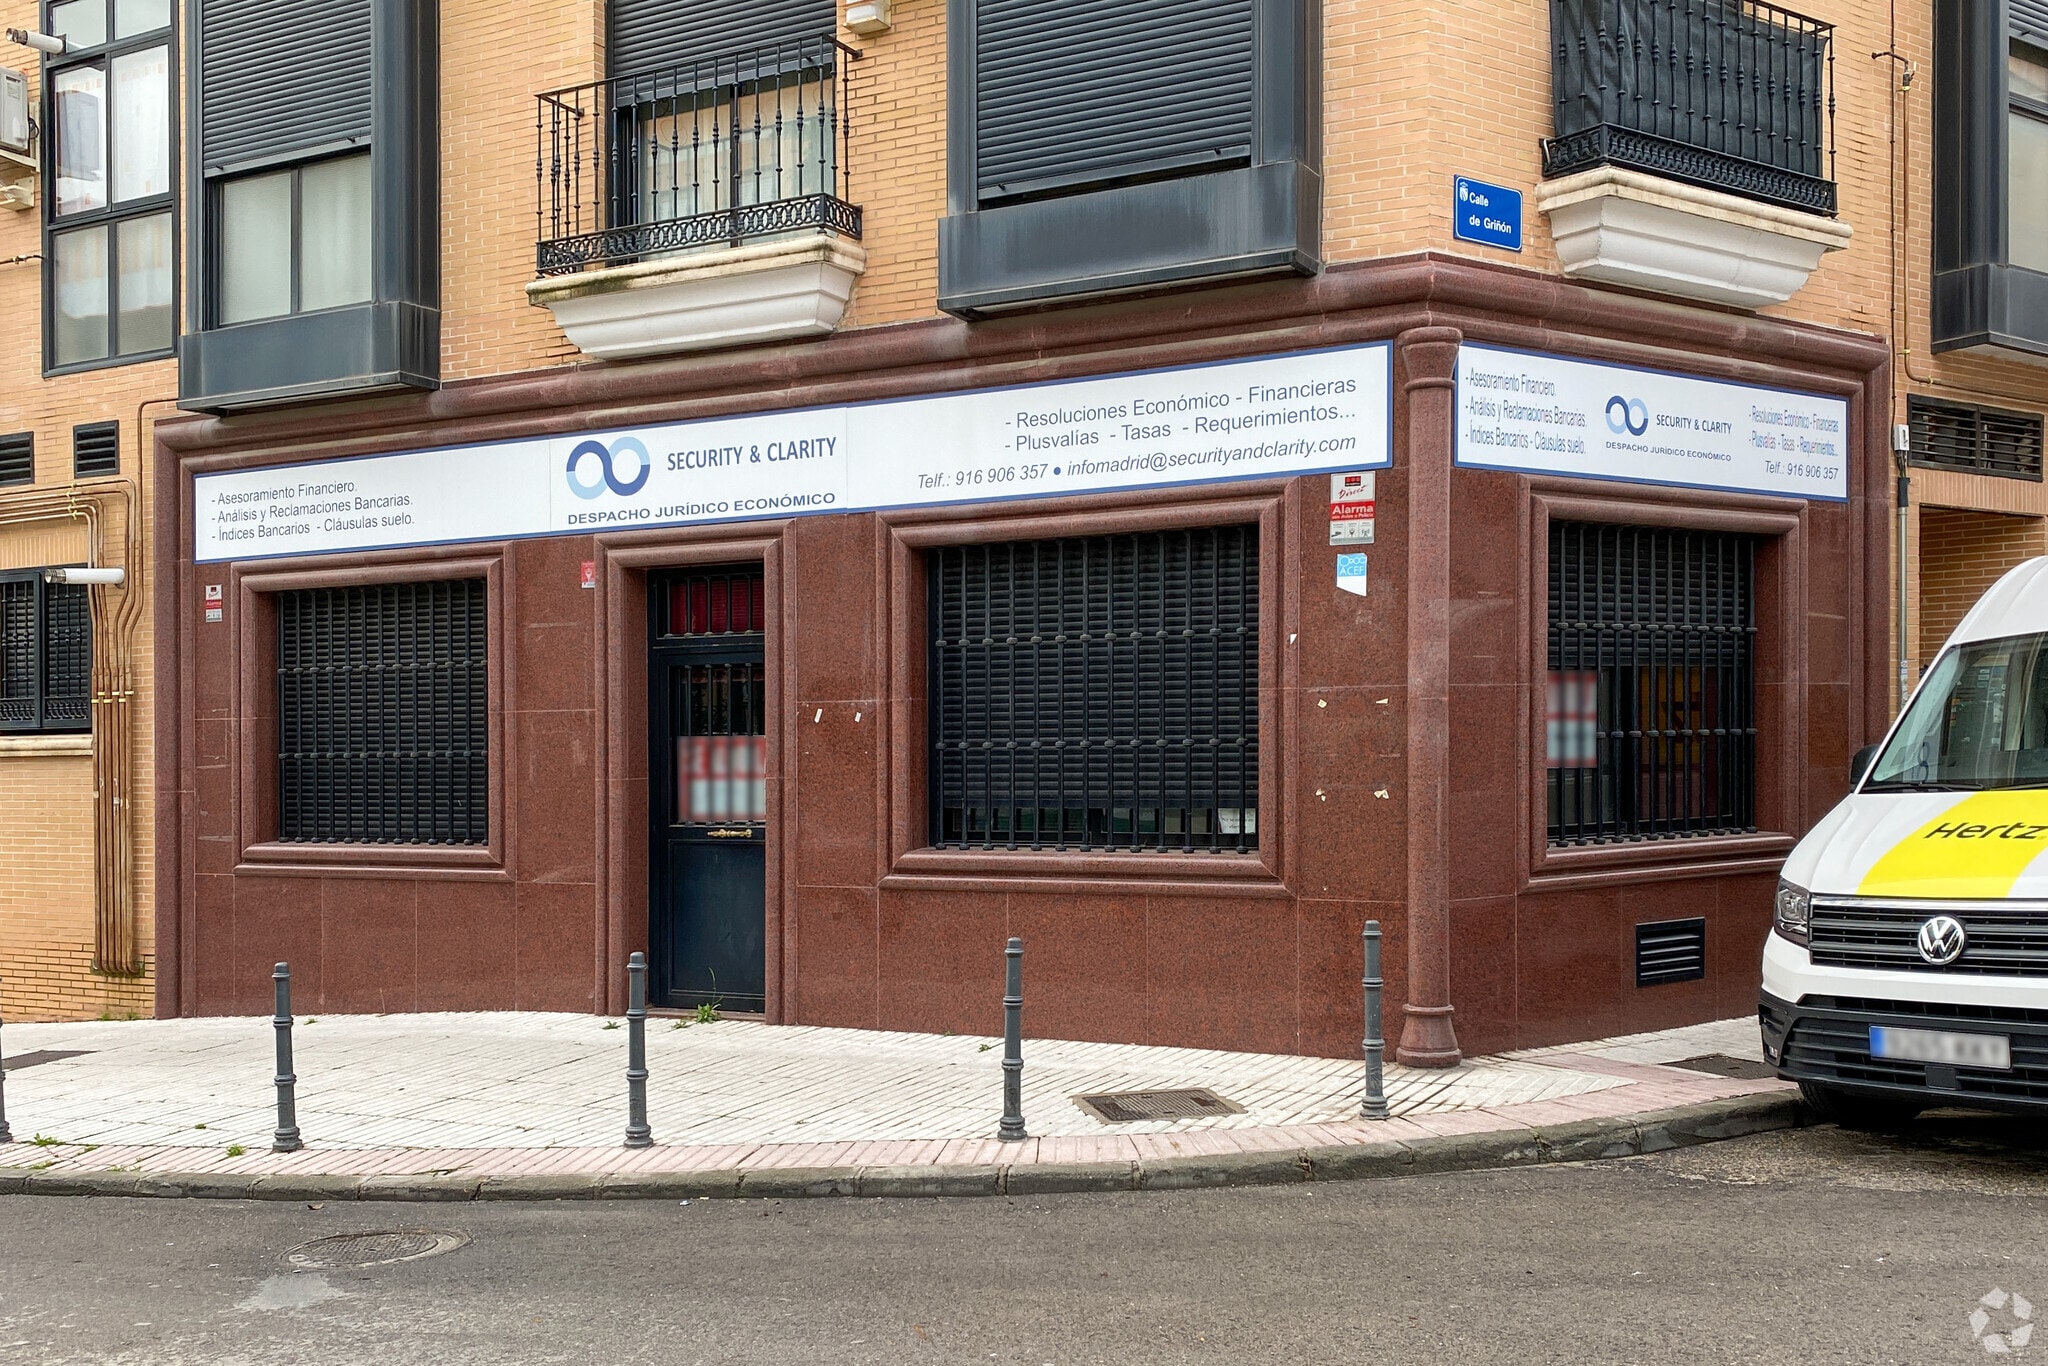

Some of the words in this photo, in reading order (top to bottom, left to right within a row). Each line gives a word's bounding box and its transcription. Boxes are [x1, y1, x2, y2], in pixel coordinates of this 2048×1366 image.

[1469, 192, 1489, 206] Calle
[1469, 214, 1480, 227] de
[1483, 217, 1512, 234] Griñón
[1470, 367, 1519, 392] Asesoramiento
[1017, 405, 1127, 428] Resoluciones
[1133, 392, 1229, 416] Económico
[1249, 379, 1356, 403] Financieras
[1470, 396, 1496, 417] Análisis
[1497, 404, 1502, 422] y
[1503, 400, 1552, 424] Reclamaciones
[1016, 429, 1099, 451] Plusvalías
[1121, 423, 1171, 441] Tasas
[1195, 405, 1356, 434] Requerimientos...
[1656, 414, 1691, 429] SECURITY
[1694, 419, 1700, 431] &
[1702, 420, 1732, 434] CLARITY
[1496, 427, 1528, 449] Bancarios
[1534, 431, 1566, 452] Cláusulas
[1606, 441, 1648, 452] DESPACHO
[1650, 446, 1685, 457] JURÍDICO
[1687, 450, 1731, 461] ECONÓMICO
[667, 446, 743, 471] SECURITY
[749, 444, 761, 463] &
[767, 436, 837, 461] CLARITY
[918, 472, 950, 489] Telf.:
[955, 469, 983, 486] 916
[987, 466, 1015, 483] 906
[1020, 463, 1048, 480] 357
[1067, 436, 1356, 476] infomadrid@securityandclarity.com
[1787, 463, 1803, 477] 916
[1805, 464, 1821, 478] 906
[1823, 466, 1838, 480] 357
[217, 487, 295, 505] Asesoramiento
[298, 481, 357, 497] Financiero.
[217, 508, 257, 523] Análisis
[260, 509, 266, 523] y
[269, 500, 351, 518] Reclamaciones
[354, 493, 413, 510] Bancarias.
[568, 508, 650, 525] DESPACHO
[655, 501, 728, 518] JURÍDICO
[734, 492, 836, 511] ECONÓMICO
[1332, 504, 1374, 514] Alarma
[218, 525, 255, 541] Índices
[258, 522, 310, 538] Bancarios
[324, 515, 378, 532] Cláusulas
[381, 512, 415, 527] suelo.
[1340, 566, 1366, 576] ACEF
[1922, 822, 2048, 839] Hertz
